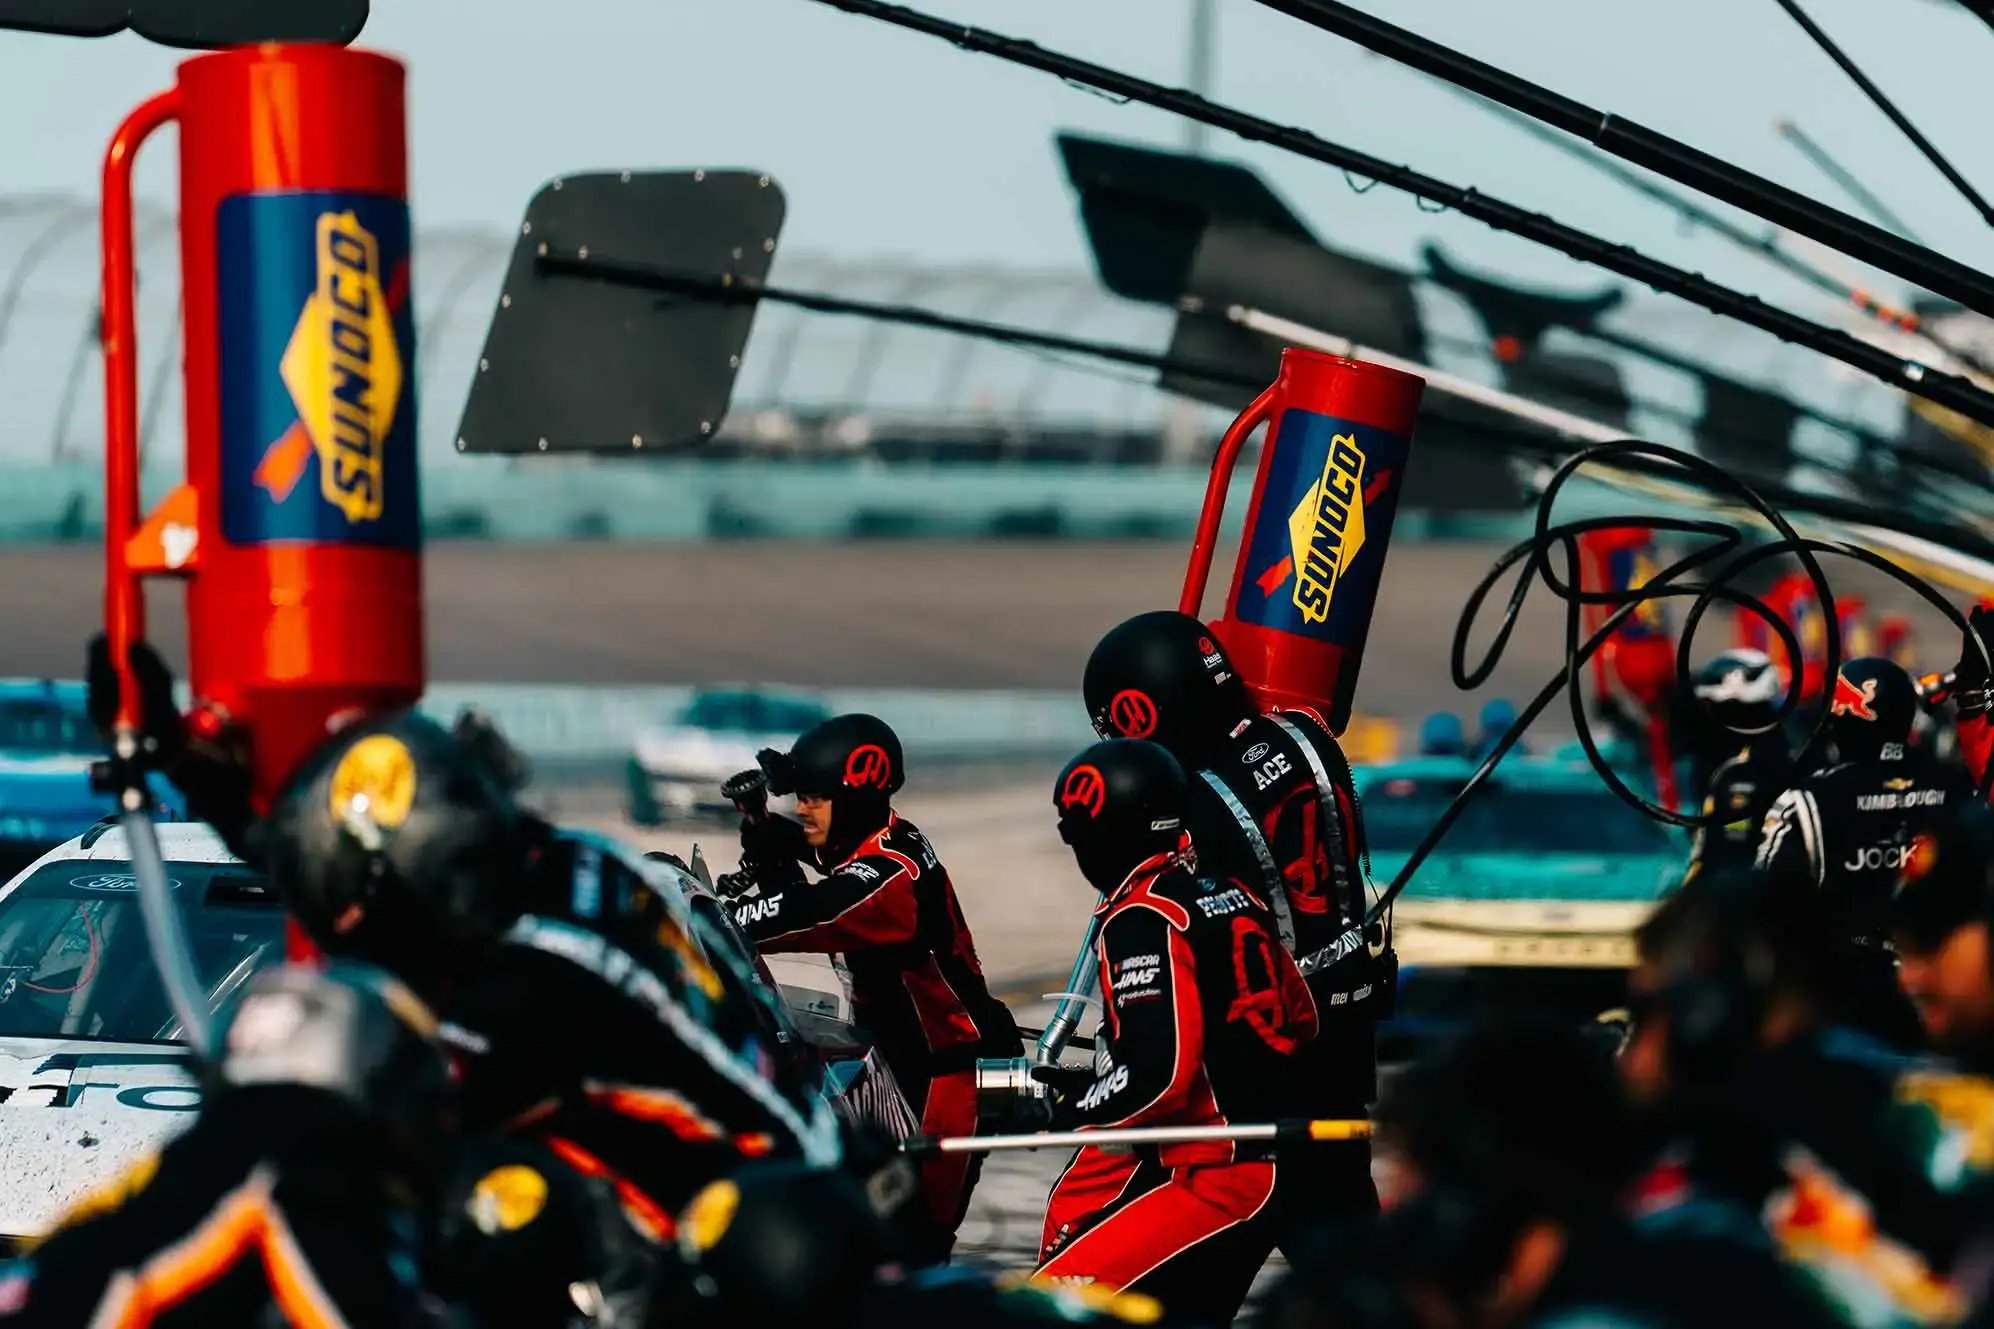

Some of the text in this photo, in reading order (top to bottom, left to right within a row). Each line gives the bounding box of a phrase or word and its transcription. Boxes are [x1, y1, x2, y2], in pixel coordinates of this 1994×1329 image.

[329, 229, 372, 502] SUNOCO
[1297, 440, 1362, 617] SUNOCO
[1253, 752, 1293, 791] ACE
[1113, 967, 1161, 990] HAAS
[1076, 1064, 1129, 1111] HAAS
